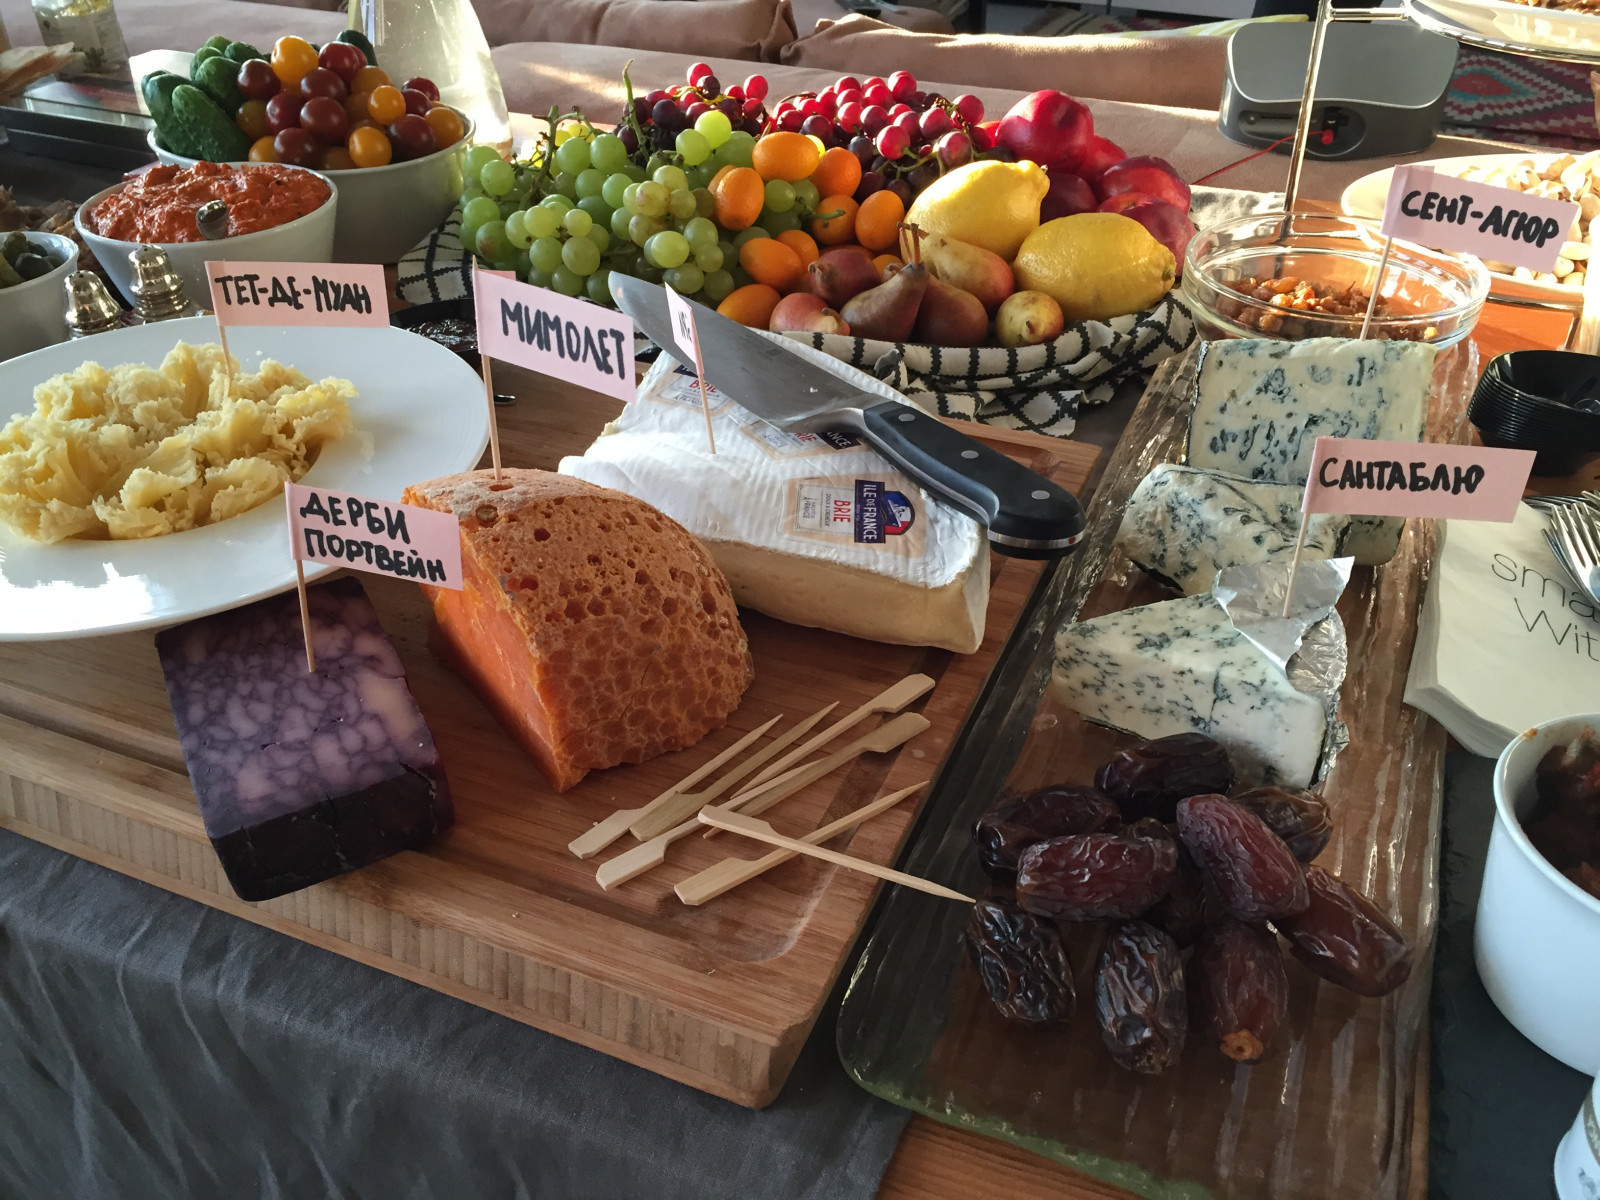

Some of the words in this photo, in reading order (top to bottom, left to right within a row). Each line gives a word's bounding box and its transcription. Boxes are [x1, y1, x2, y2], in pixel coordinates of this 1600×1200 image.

[1401, 190, 1559, 248] СЕНТ-АГЮР
[214, 274, 372, 314] ТЕТ-ДЕ-МУАН
[500, 298, 625, 380] МИМОЛЕТ
[863, 484, 877, 498] ILE
[1319, 457, 1485, 495] САНТАБЛЮ
[300, 493, 410, 544] ДЕРБИ
[833, 499, 851, 523] BRIE
[863, 507, 878, 540] FRANCE
[304, 528, 446, 582] ПОРТВЕЙН
